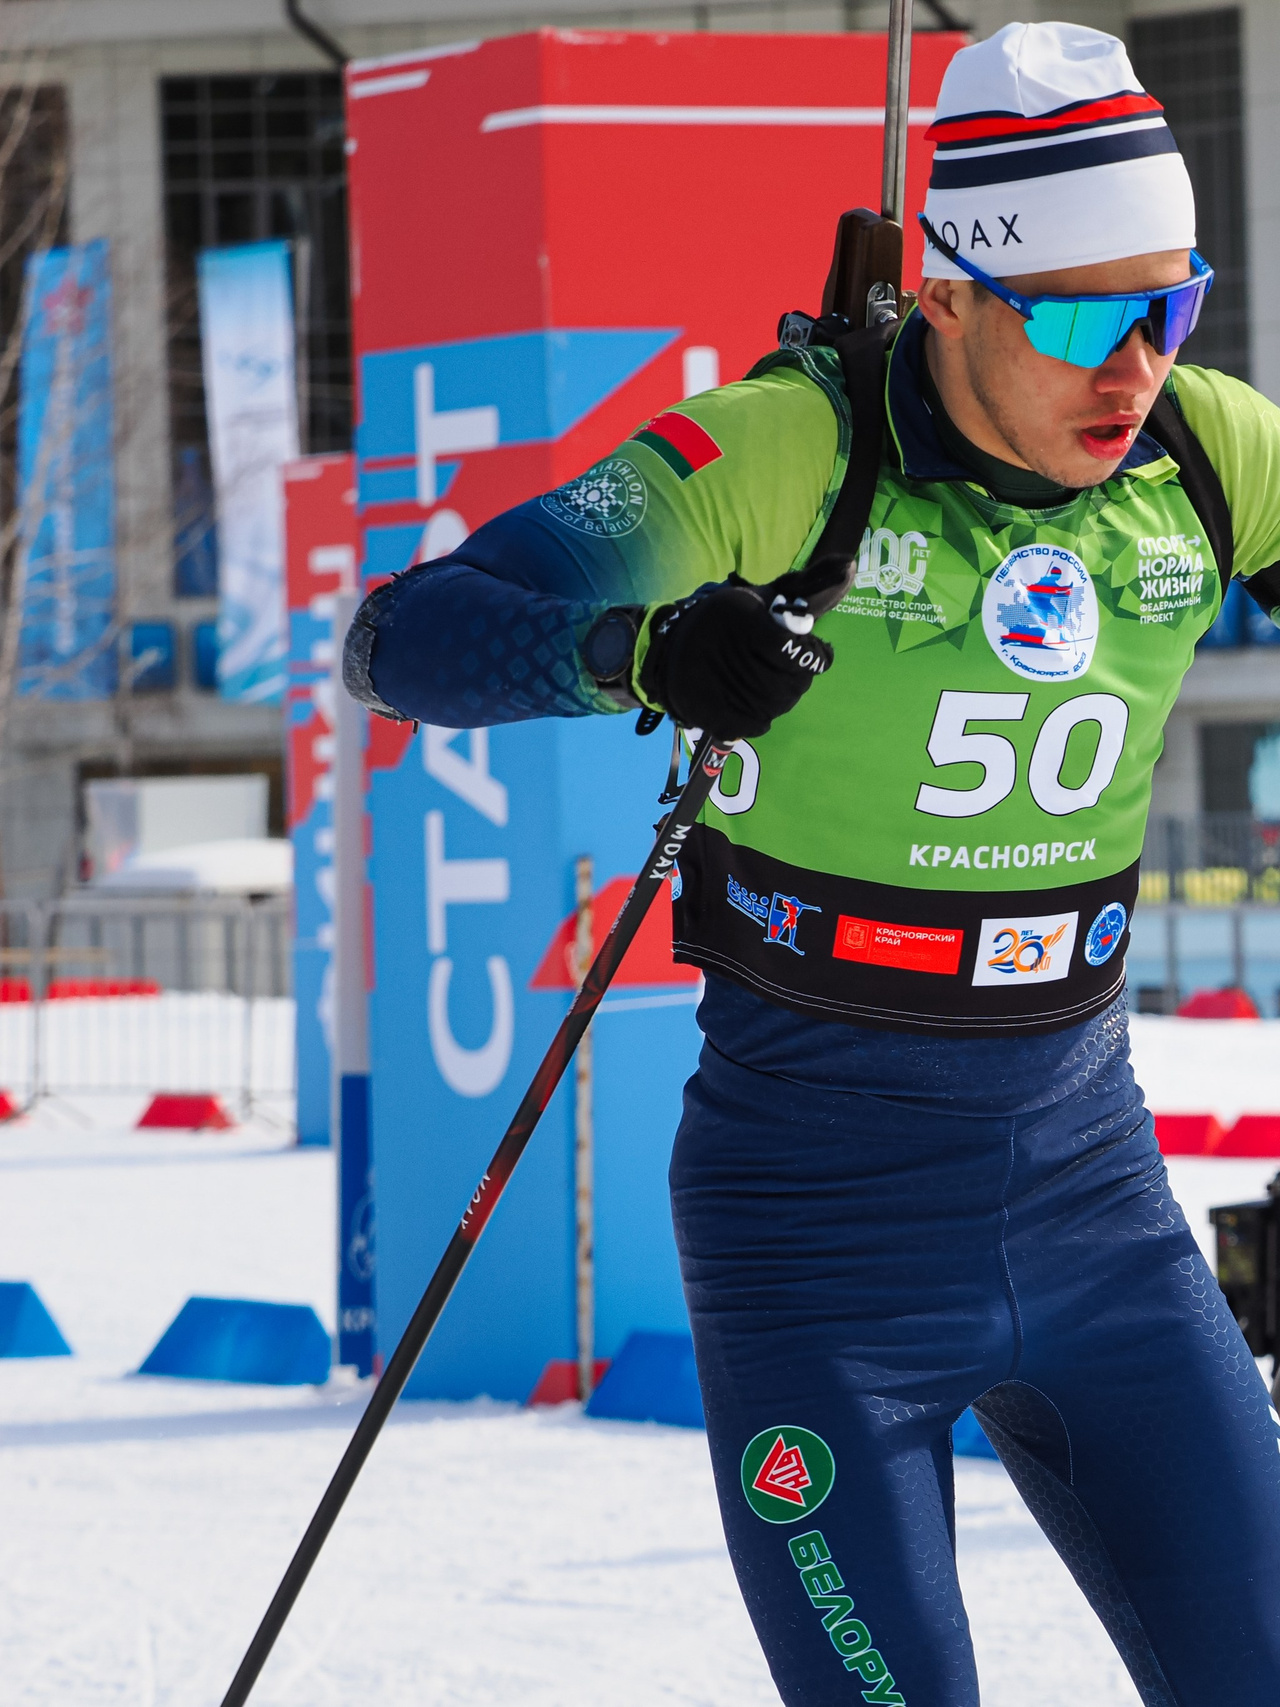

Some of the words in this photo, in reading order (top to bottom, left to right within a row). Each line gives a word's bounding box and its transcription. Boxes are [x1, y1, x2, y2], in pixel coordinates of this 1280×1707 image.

[585, 511, 637, 534] Belarus
[912, 548, 931, 558] ЛЕТ
[1137, 533, 1188, 557] СПОРТ
[1052, 549, 1088, 584] РОССИИ
[1138, 552, 1204, 578] НОРМА
[1139, 573, 1204, 600] ЖИЗНИ
[832, 603, 886, 618] ССИЙСКОЙ
[888, 611, 947, 624] ФЕДЕРАЦИИ
[842, 595, 906, 610] НИСТЕРСТВО
[908, 601, 943, 613] СПОРТА
[1139, 594, 1201, 612] ФЕДЕРАЛЬНЫЙ
[1139, 611, 1174, 625] ПРОЕКТ
[1010, 654, 1070, 678] Красноярск
[914, 689, 1130, 819] 50
[649, 823, 693, 880] MOAX
[909, 838, 1097, 870] КРАСНОЯРСК
[874, 935, 901, 946] КРАЙ
[876, 926, 956, 943] КРАСНОЯРСКИЙ
[788, 1529, 907, 1707] БЕЛОРУ
